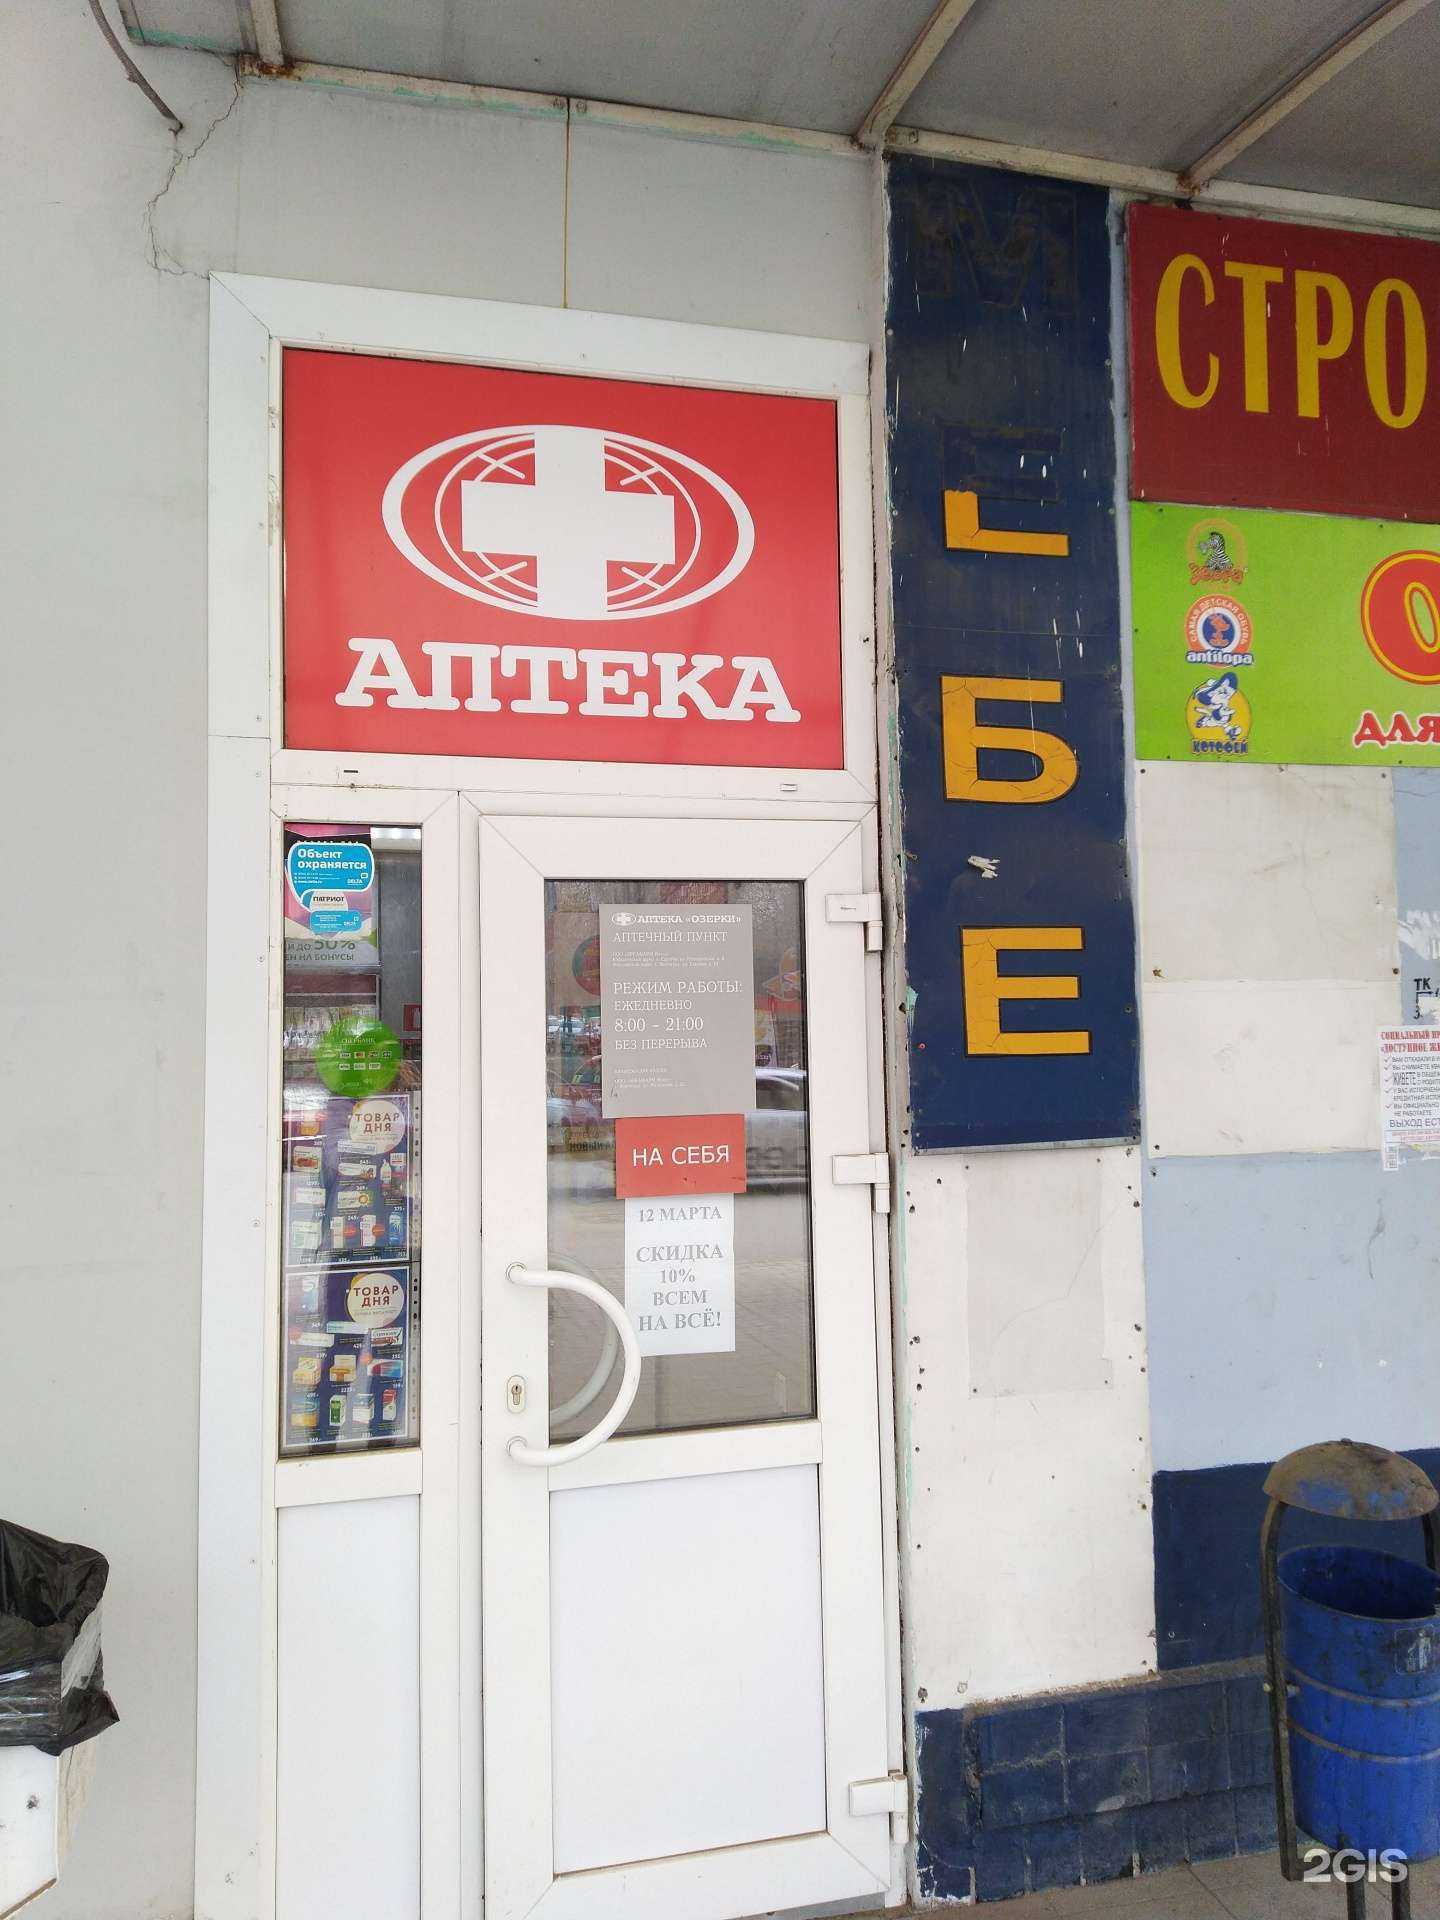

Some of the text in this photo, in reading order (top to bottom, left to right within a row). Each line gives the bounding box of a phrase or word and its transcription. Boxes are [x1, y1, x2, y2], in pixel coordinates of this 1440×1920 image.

[1155, 253, 1427, 429] СТРО
[1186, 650, 1253, 667] antilopa
[335, 637, 801, 723] АПТЕКА
[1353, 711, 1440, 747] ДЛЯ
[297, 848, 343, 859] Объект
[297, 860, 367, 870] охраняется
[637, 914, 683, 924] АПТЕКА
[614, 929, 729, 942] АПТЕЧНЫЙ ПУНКТ
[297, 943, 312, 951] ДО
[314, 953, 354, 961] БОНУСЫ
[613, 980, 743, 995] РЕЖИМ РАБОТЫ:
[614, 999, 693, 1012] ЕЖЕДНЕВНО
[614, 1017, 646, 1033] 8:00
[665, 1016, 704, 1032] 21:00
[1380, 1030, 1430, 1040] СОЦИАЛЬНЫЙ
[615, 1038, 708, 1050] БЕЗ ПЕРЕРЫВА
[354, 1112, 400, 1122] ТОВАР
[1389, 1118, 1423, 1129] ВЫХОД
[363, 1123, 392, 1134] ДНЯ
[632, 1145, 730, 1167] НА СЕБЯ
[638, 1206, 723, 1222] 12 МАРТА
[635, 1244, 724, 1263] СКИДКА
[660, 1269, 696, 1284] 10%
[353, 1285, 399, 1297] ТОВАР
[361, 1296, 390, 1308] ДНЯ
[652, 1290, 708, 1307] ВСЕМ
[638, 1308, 722, 1332] НА ВСЁ!
